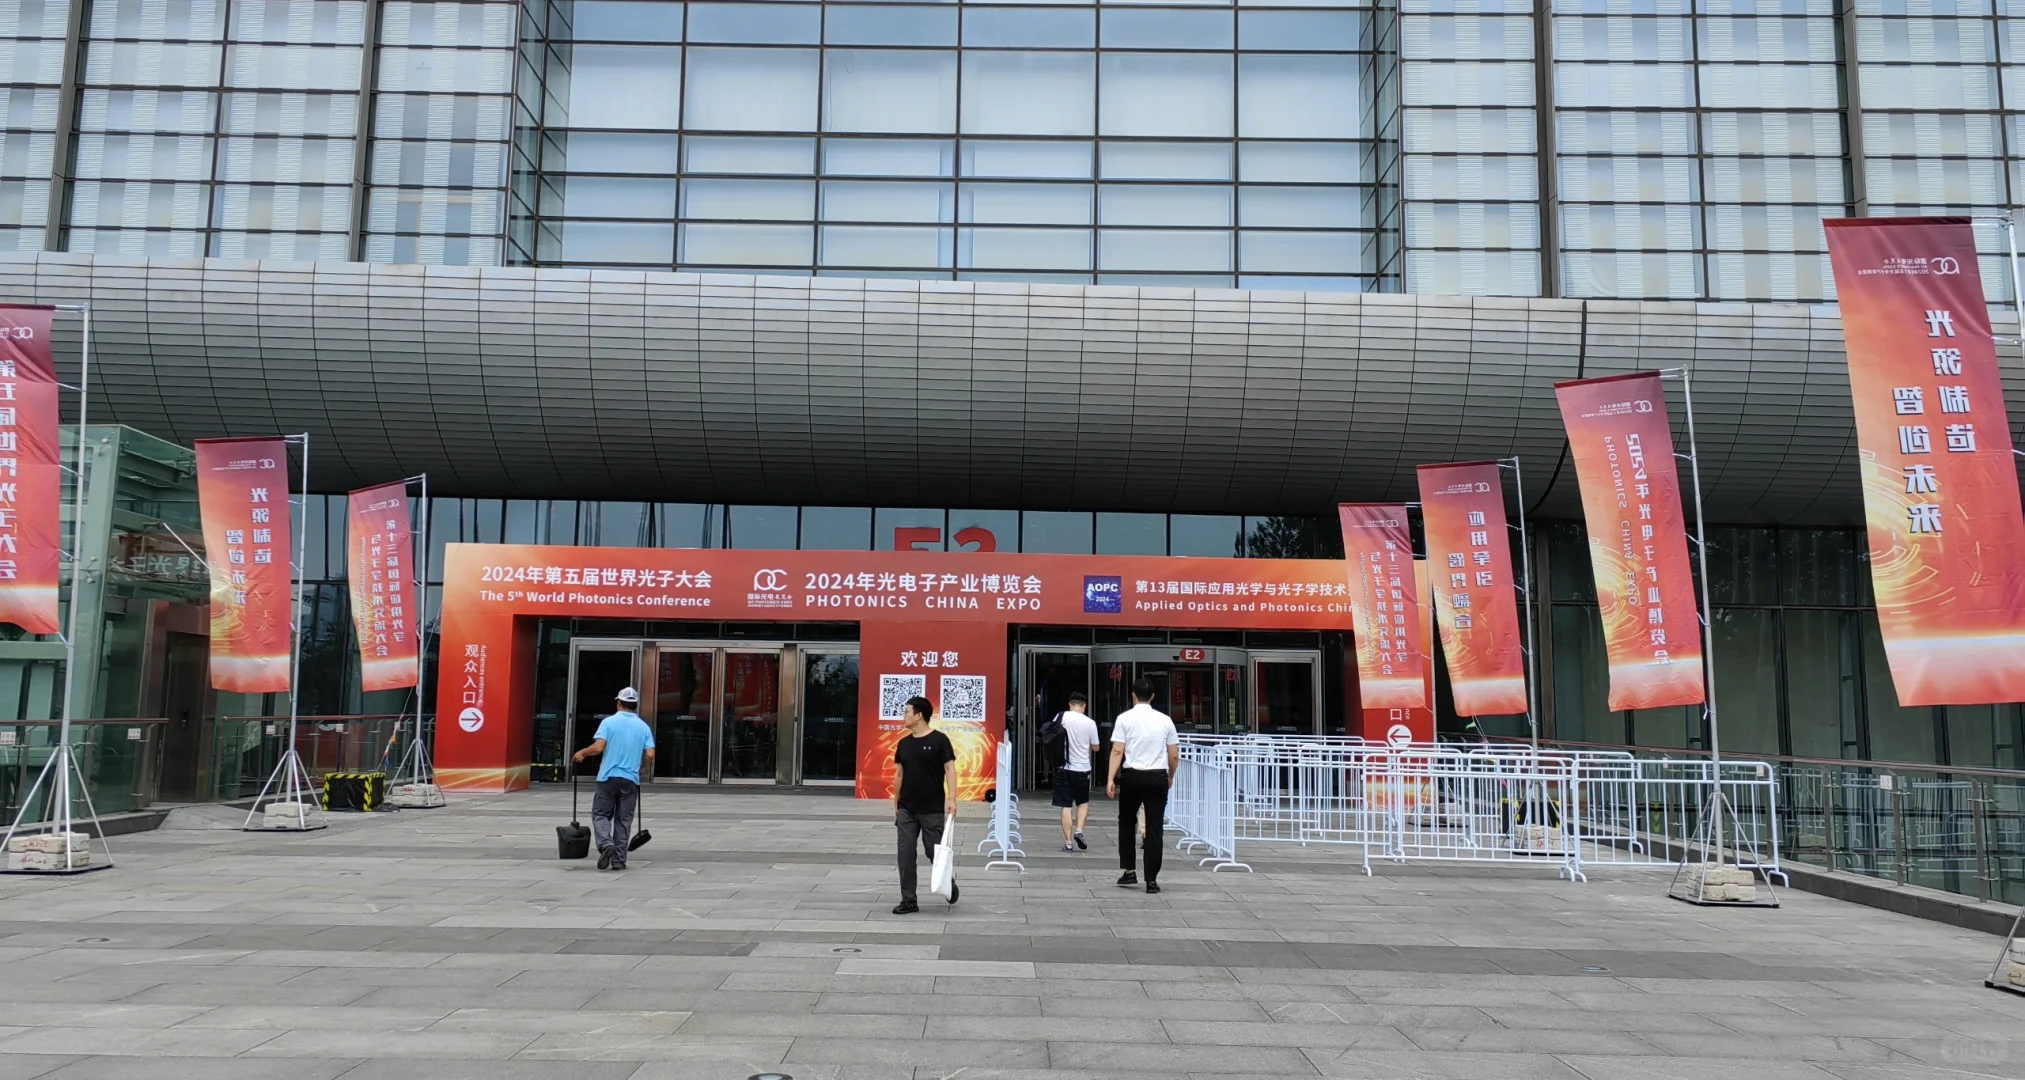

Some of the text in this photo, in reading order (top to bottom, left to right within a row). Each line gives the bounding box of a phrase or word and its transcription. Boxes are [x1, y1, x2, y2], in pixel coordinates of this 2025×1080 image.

[480, 564, 712, 589] 2024年第五届世界光子大会
[805, 571, 1042, 597] 2024年光电子产业博览会
[1087, 583, 1118, 592] AOPC
[1135, 578, 1350, 597] 第13届国际应用光学与光子学技术
[479, 590, 711, 607] The 5th World Photonics Conference
[806, 595, 1041, 611] PHOTONICS CHINA EXPO
[1135, 600, 1183, 614] Applied
[1188, 601, 1228, 614] Optics
[1232, 601, 1255, 612] and
[1260, 602, 1323, 613] Photonics
[900, 650, 959, 668] 欢迎您
[1185, 649, 1200, 660] E2
[463, 644, 479, 704] 观众入口
